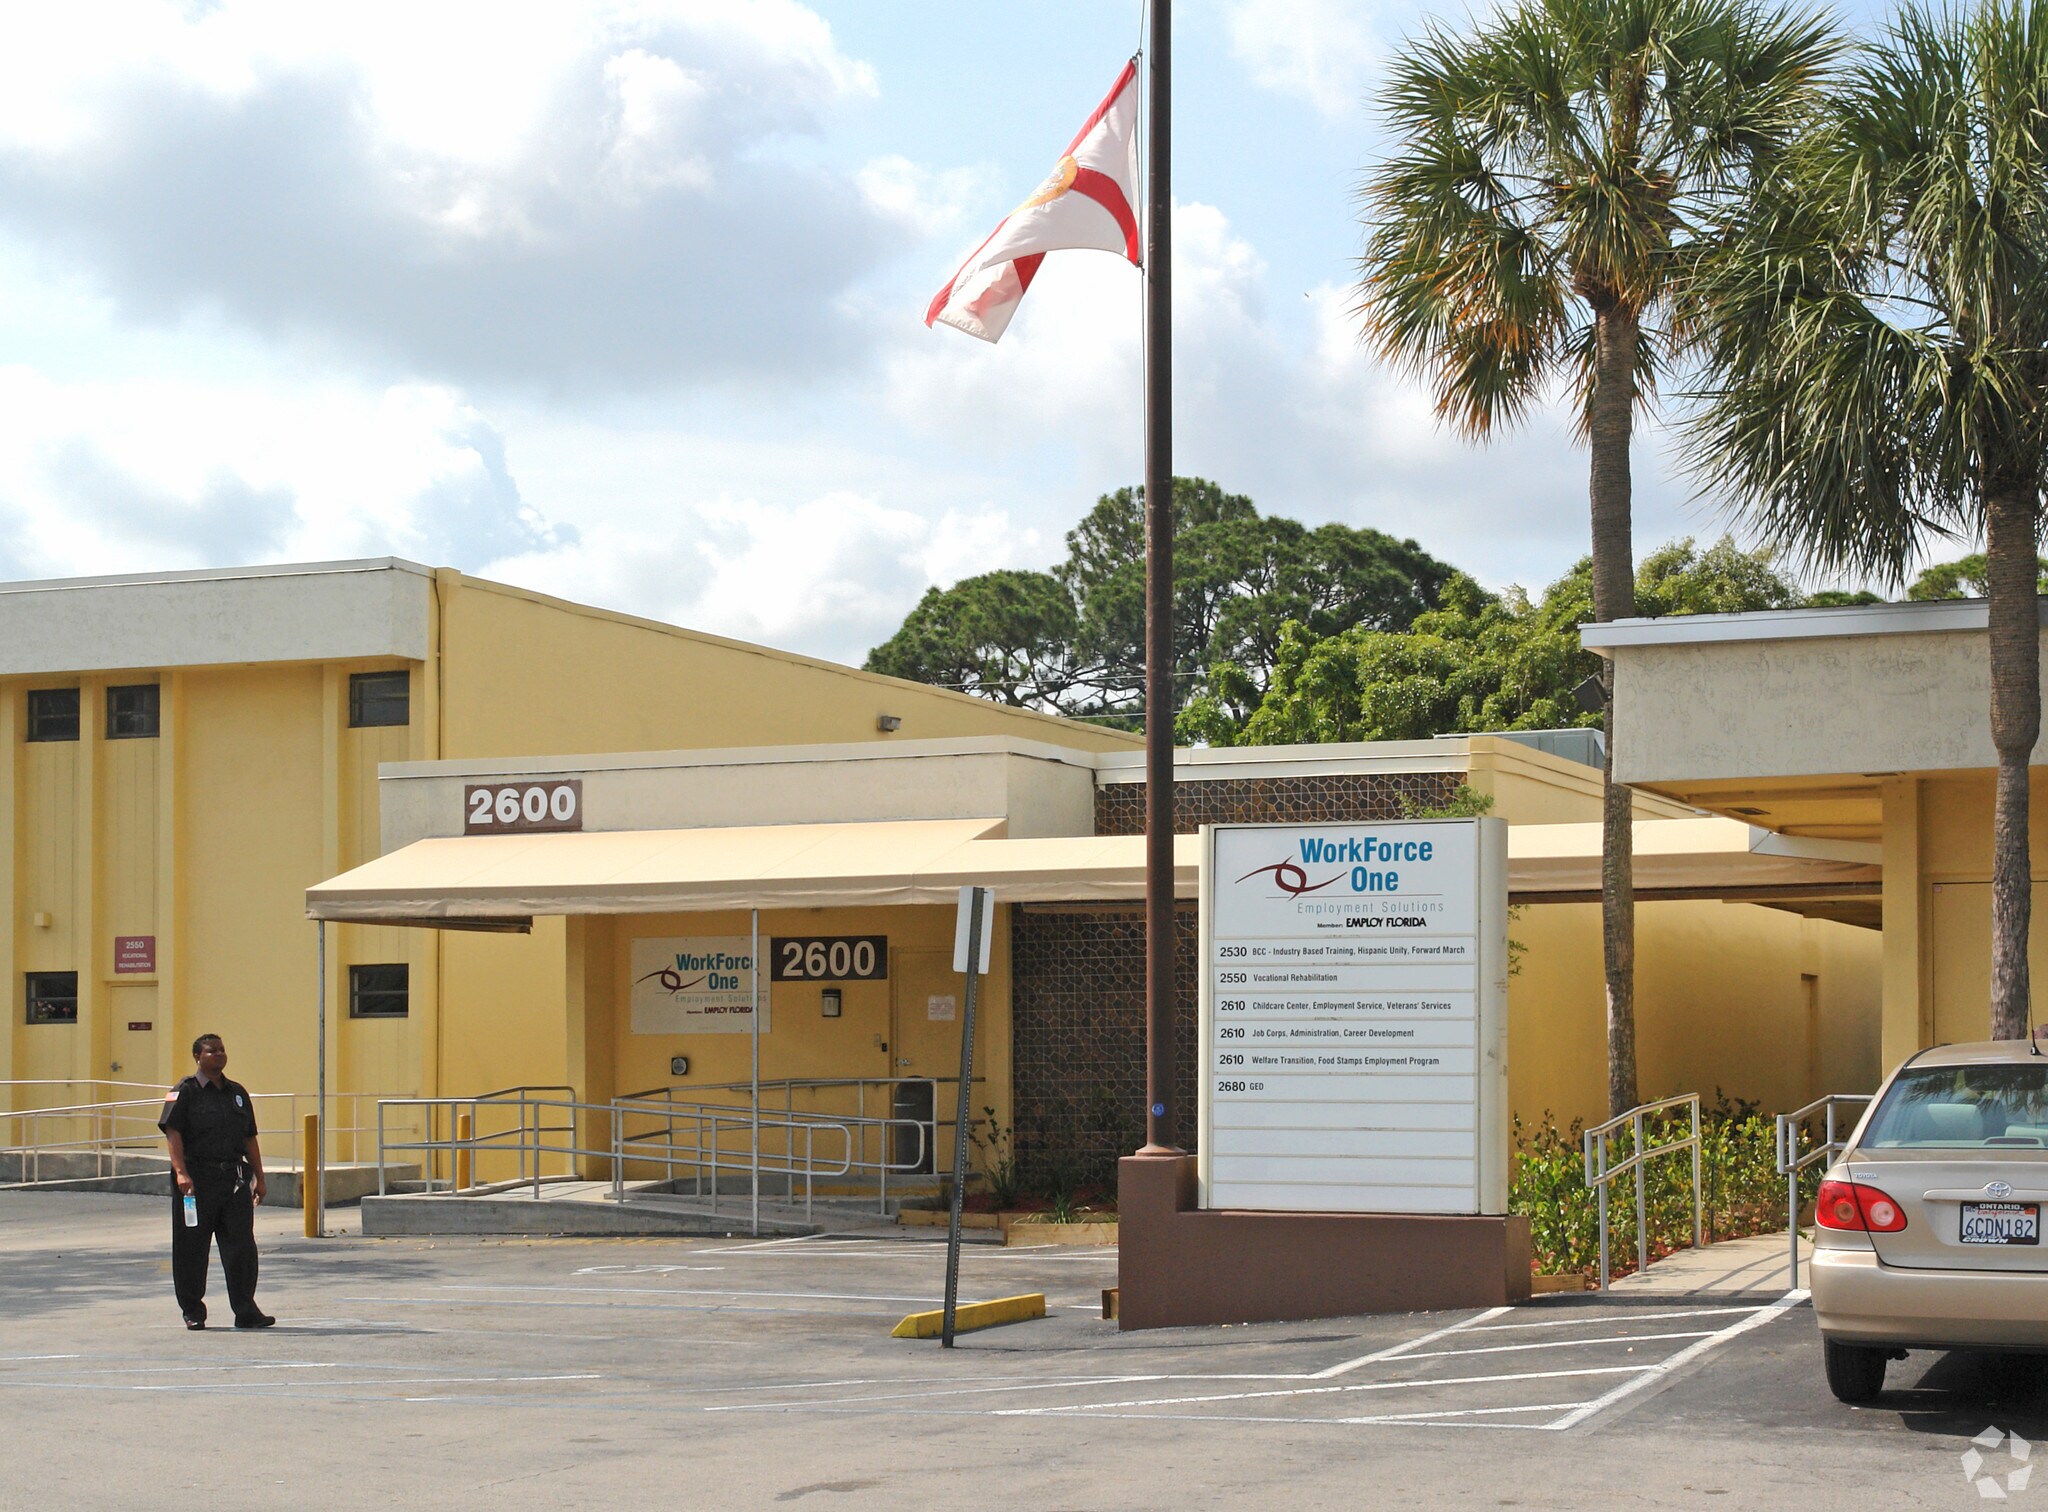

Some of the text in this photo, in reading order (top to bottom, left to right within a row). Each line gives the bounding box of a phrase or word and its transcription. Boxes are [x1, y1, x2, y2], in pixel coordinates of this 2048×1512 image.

[468, 785, 577, 824] 2600
[1299, 836, 1433, 864] WorkForce
[1350, 865, 1399, 893] One
[1297, 900, 1444, 916] Employment Solutions
[1346, 917, 1384, 928] EMPLOY
[1386, 916, 1427, 928] FLORIDA
[125, 941, 145, 949] 2550
[1219, 946, 1248, 958] 2530
[1252, 947, 1267, 956] BCC
[1273, 946, 1301, 957] Industry
[1302, 946, 1324, 956] Based
[1325, 946, 1356, 957] Training,
[1357, 946, 1388, 956] Hispanic
[1389, 946, 1410, 956] Unity,
[1411, 945, 1441, 955] Forward
[1442, 945, 1465, 955] March
[676, 952, 754, 971] WorkForc
[781, 940, 876, 978] 2600
[708, 972, 739, 990] One
[1219, 972, 1338, 984] 2550 Vocational Rehabilitation
[704, 1006, 728, 1014] EMPLOY
[1220, 1000, 1246, 1011] 2610
[1252, 1001, 1285, 1010] Childcare
[1286, 1001, 1311, 1011] Center,
[1312, 1001, 1355, 1011] Employment
[1356, 1001, 1385, 1011] Service,
[1421, 1001, 1452, 1010] Services
[1220, 1027, 1414, 1039] 2610 Job Corps, Administration, Career Development
[1219, 1054, 1440, 1066] 2610 Welfare Transition, Food Stamps Employment Program
[1218, 1081, 1264, 1092] 2680 GED
[1965, 1218, 2033, 1238] 6CDN182
